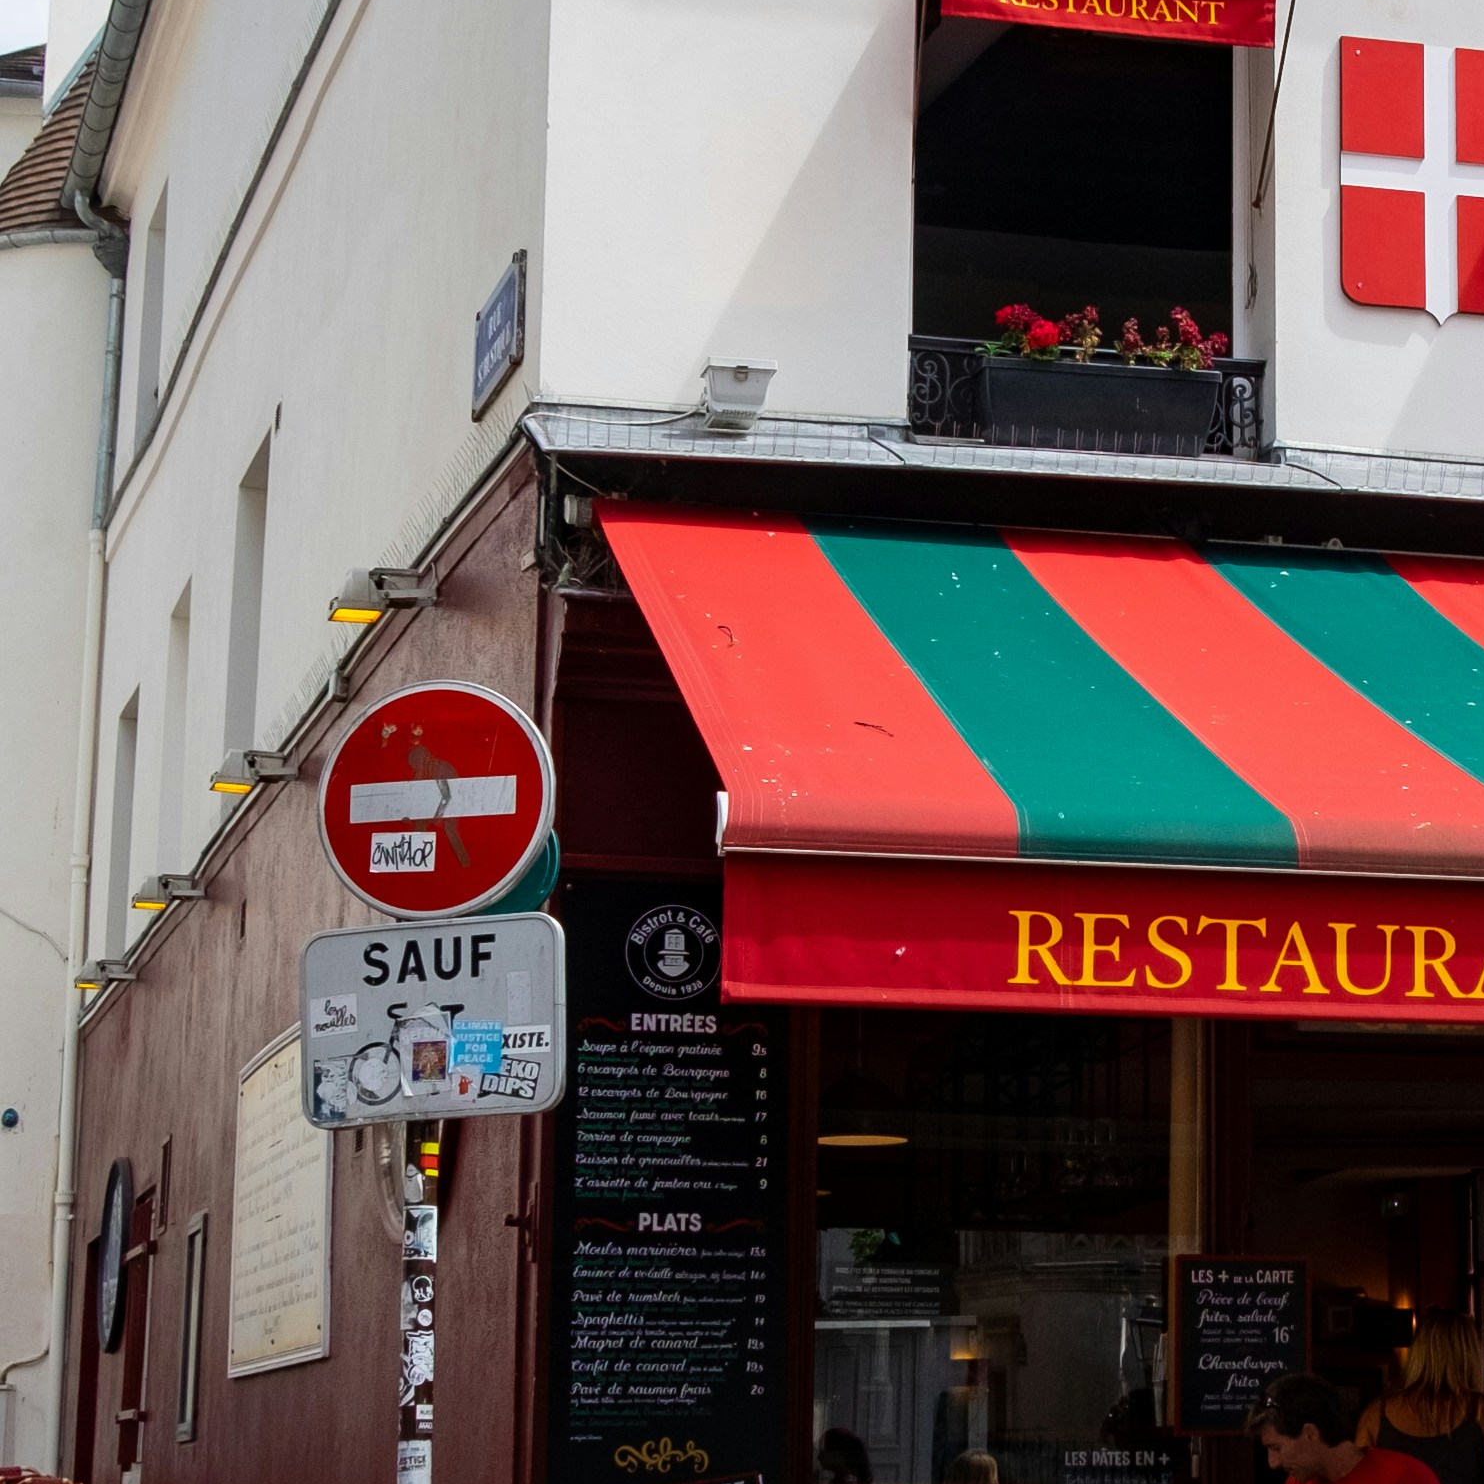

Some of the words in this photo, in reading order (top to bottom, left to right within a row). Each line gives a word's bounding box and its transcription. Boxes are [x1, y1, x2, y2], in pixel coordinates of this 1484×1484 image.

[630, 910, 675, 946] Bistrot
[677, 911, 687, 923] &
[689, 915, 718, 944] Café
[362, 933, 497, 987] SAUF
[642, 976, 678, 995] Depuis
[454, 1020, 503, 1030] CLIMATE
[631, 1012, 718, 1035] ENTRÉES
[456, 1032, 501, 1042] JUSTICE
[464, 1043, 488, 1052] FOR
[577, 1039, 617, 1056] Soupe
[619, 1041, 629, 1053] à
[630, 1040, 675, 1057] l'oignon
[677, 1043, 723, 1058] gratinée
[456, 1053, 494, 1063] PEACE
[577, 1063, 586, 1074] 6
[587, 1064, 640, 1078] escargots
[642, 1063, 658, 1076] de
[662, 1062, 731, 1081] Bourgogne
[759, 1067, 768, 1079] 8
[481, 1073, 536, 1099] DIPS
[578, 1087, 590, 1098] 12
[591, 1087, 643, 1101] escargots
[646, 1087, 662, 1098] de
[664, 1087, 730, 1103] Bourgogne
[576, 1108, 627, 1122] Saumon
[629, 1111, 657, 1124] fumé
[661, 1113, 686, 1122] avec
[687, 1111, 720, 1122] toasts
[755, 1112, 768, 1123] 17
[577, 1130, 618, 1144] Terrine
[620, 1130, 635, 1143] de
[636, 1134, 692, 1147] campagne
[575, 1154, 619, 1166] Cuisses
[621, 1154, 636, 1166] de
[637, 1154, 702, 1168] grenouilles
[755, 1156, 768, 1168] 21
[574, 1177, 630, 1190] L'assiette
[633, 1176, 649, 1189] de
[651, 1177, 691, 1192] jambon
[693, 1179, 712, 1189] cru
[759, 1178, 768, 1190] 9
[637, 1212, 703, 1234] PLATS
[573, 1240, 623, 1257] Moules
[626, 1242, 699, 1258] marinières
[619, 1265, 632, 1279] de
[633, 1266, 675, 1280] volaille
[1190, 1269, 1214, 1285] LES
[1218, 1270, 1230, 1285] +
[1256, 1269, 1295, 1285] CARTE
[571, 1289, 603, 1304] Pavé
[606, 1290, 622, 1304] de
[754, 1294, 767, 1304] 19
[1196, 1288, 1234, 1306] Pièce
[1236, 1291, 1253, 1306] de
[570, 1311, 645, 1329] Spaghettis
[754, 1316, 765, 1327] 14
[570, 1335, 625, 1353] Magret
[628, 1336, 647, 1350] de
[650, 1336, 700, 1350] canard
[570, 1360, 610, 1377] Confit
[613, 1360, 632, 1374] de
[635, 1359, 687, 1374] canard
[569, 1382, 602, 1397] Pavé
[607, 1382, 624, 1395] de
[626, 1384, 678, 1396] saumon
[680, 1383, 713, 1398] frais
[750, 1384, 765, 1396] 20
[1224, 1373, 1261, 1392] frites
[1064, 1450, 1088, 1467] LES
[1091, 1446, 1131, 1467] PÂTES
[1135, 1449, 1156, 1467] EN
